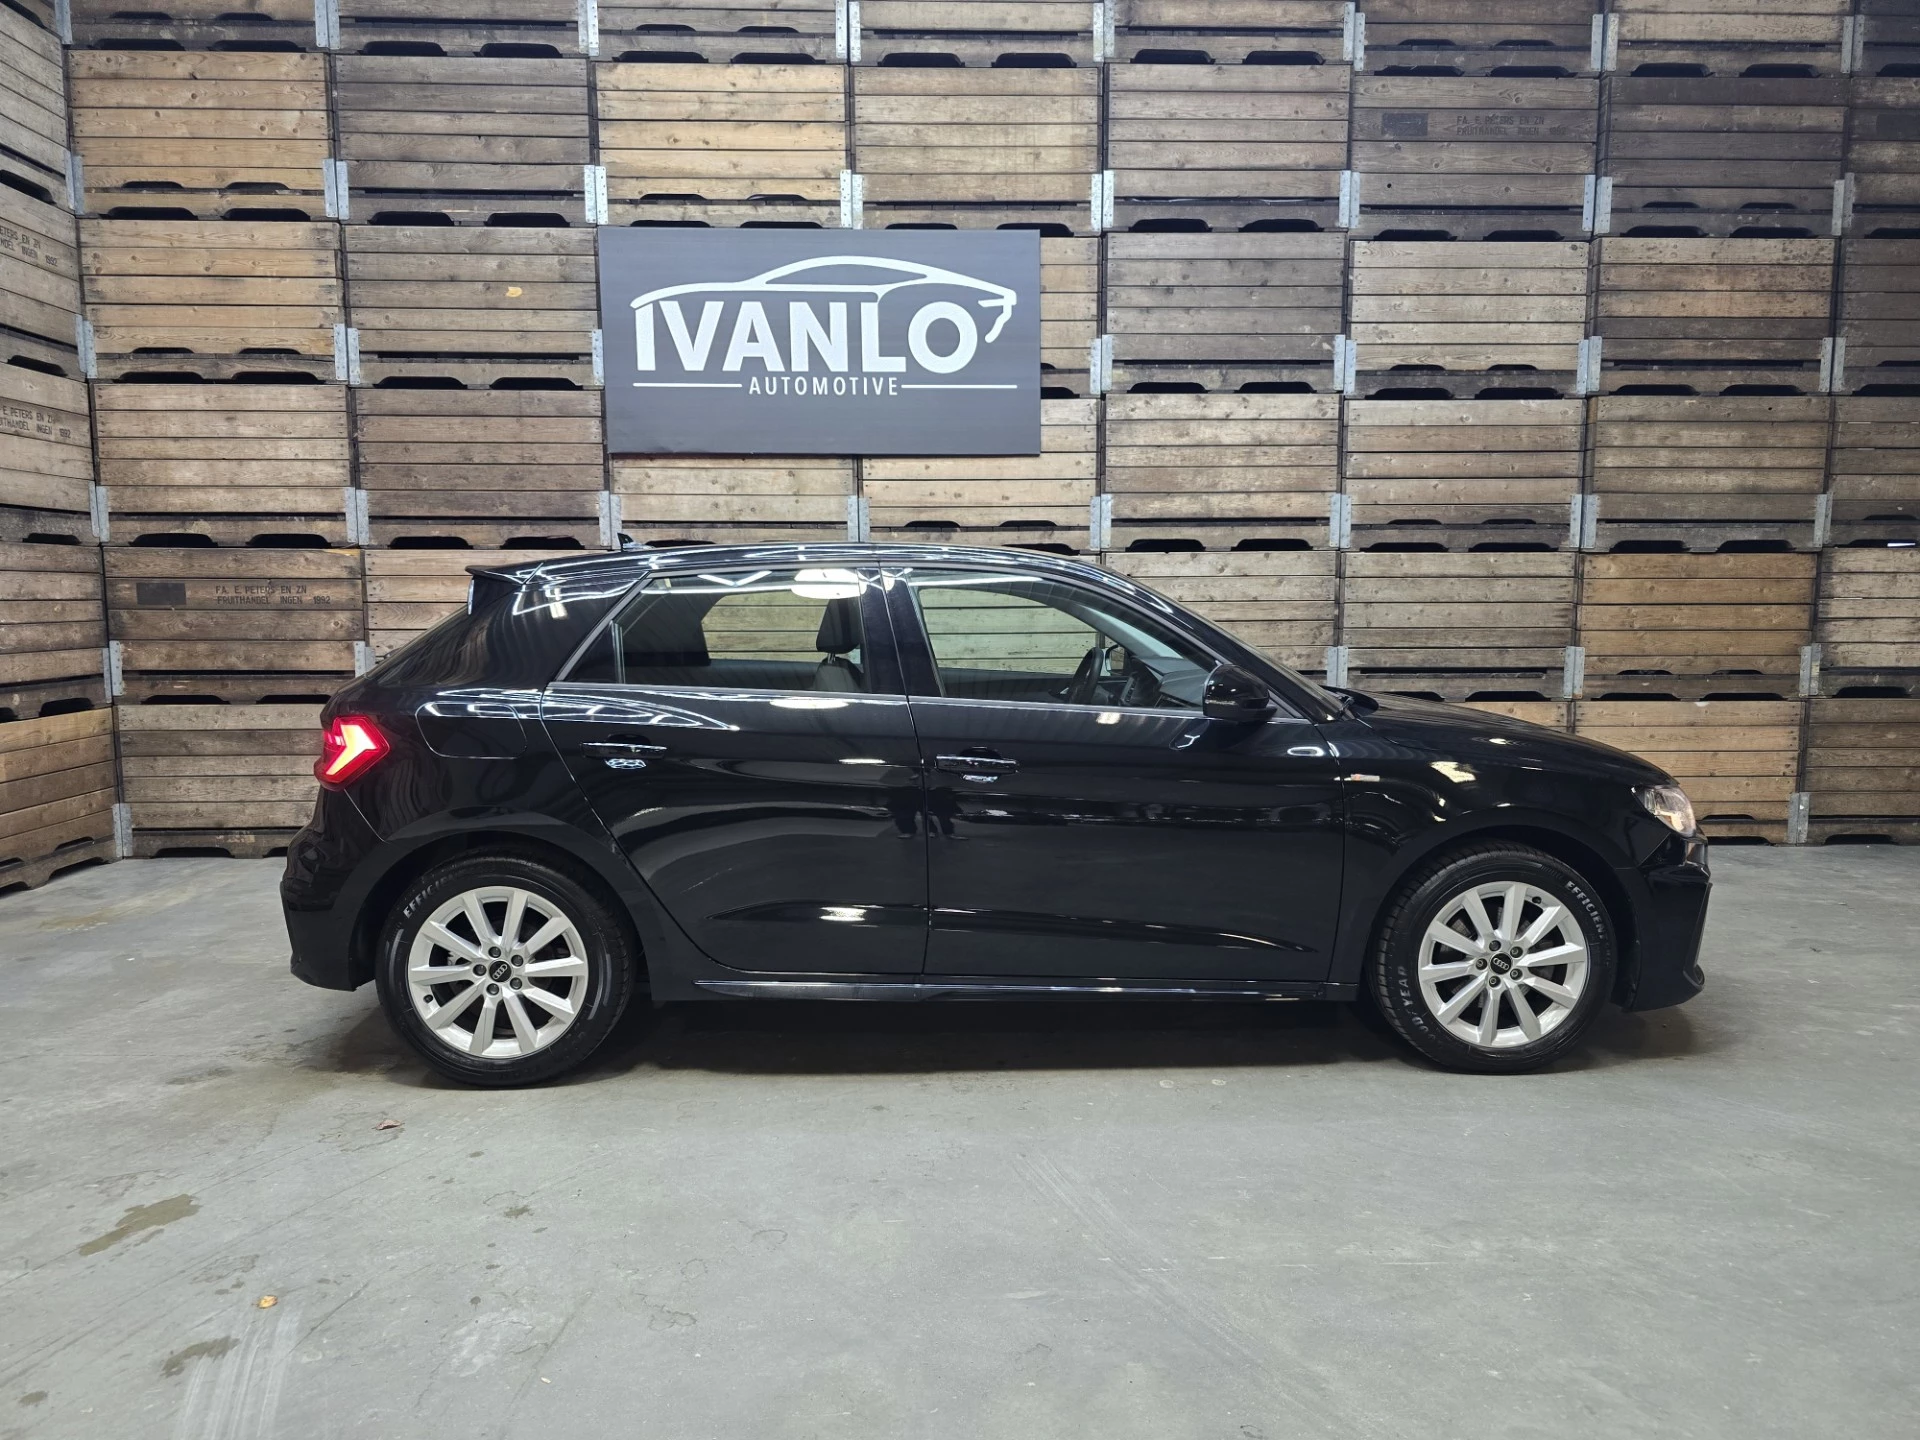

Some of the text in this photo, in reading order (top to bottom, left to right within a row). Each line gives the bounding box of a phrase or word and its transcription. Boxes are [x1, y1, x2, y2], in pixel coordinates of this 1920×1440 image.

[1520, 115, 1530, 125] EN
[1534, 115, 1544, 125] ZN
[635, 300, 978, 374] IVANLO
[749, 376, 898, 396] AUTOMOTIVE
[10, 407, 33, 420] PETERS
[36, 412, 44, 422] EN
[245, 585, 275, 594] PETERS
[280, 585, 291, 594] EN
[296, 585, 306, 594] ZN
[217, 595, 331, 605] FRUITHANDEL INGEN 1992
